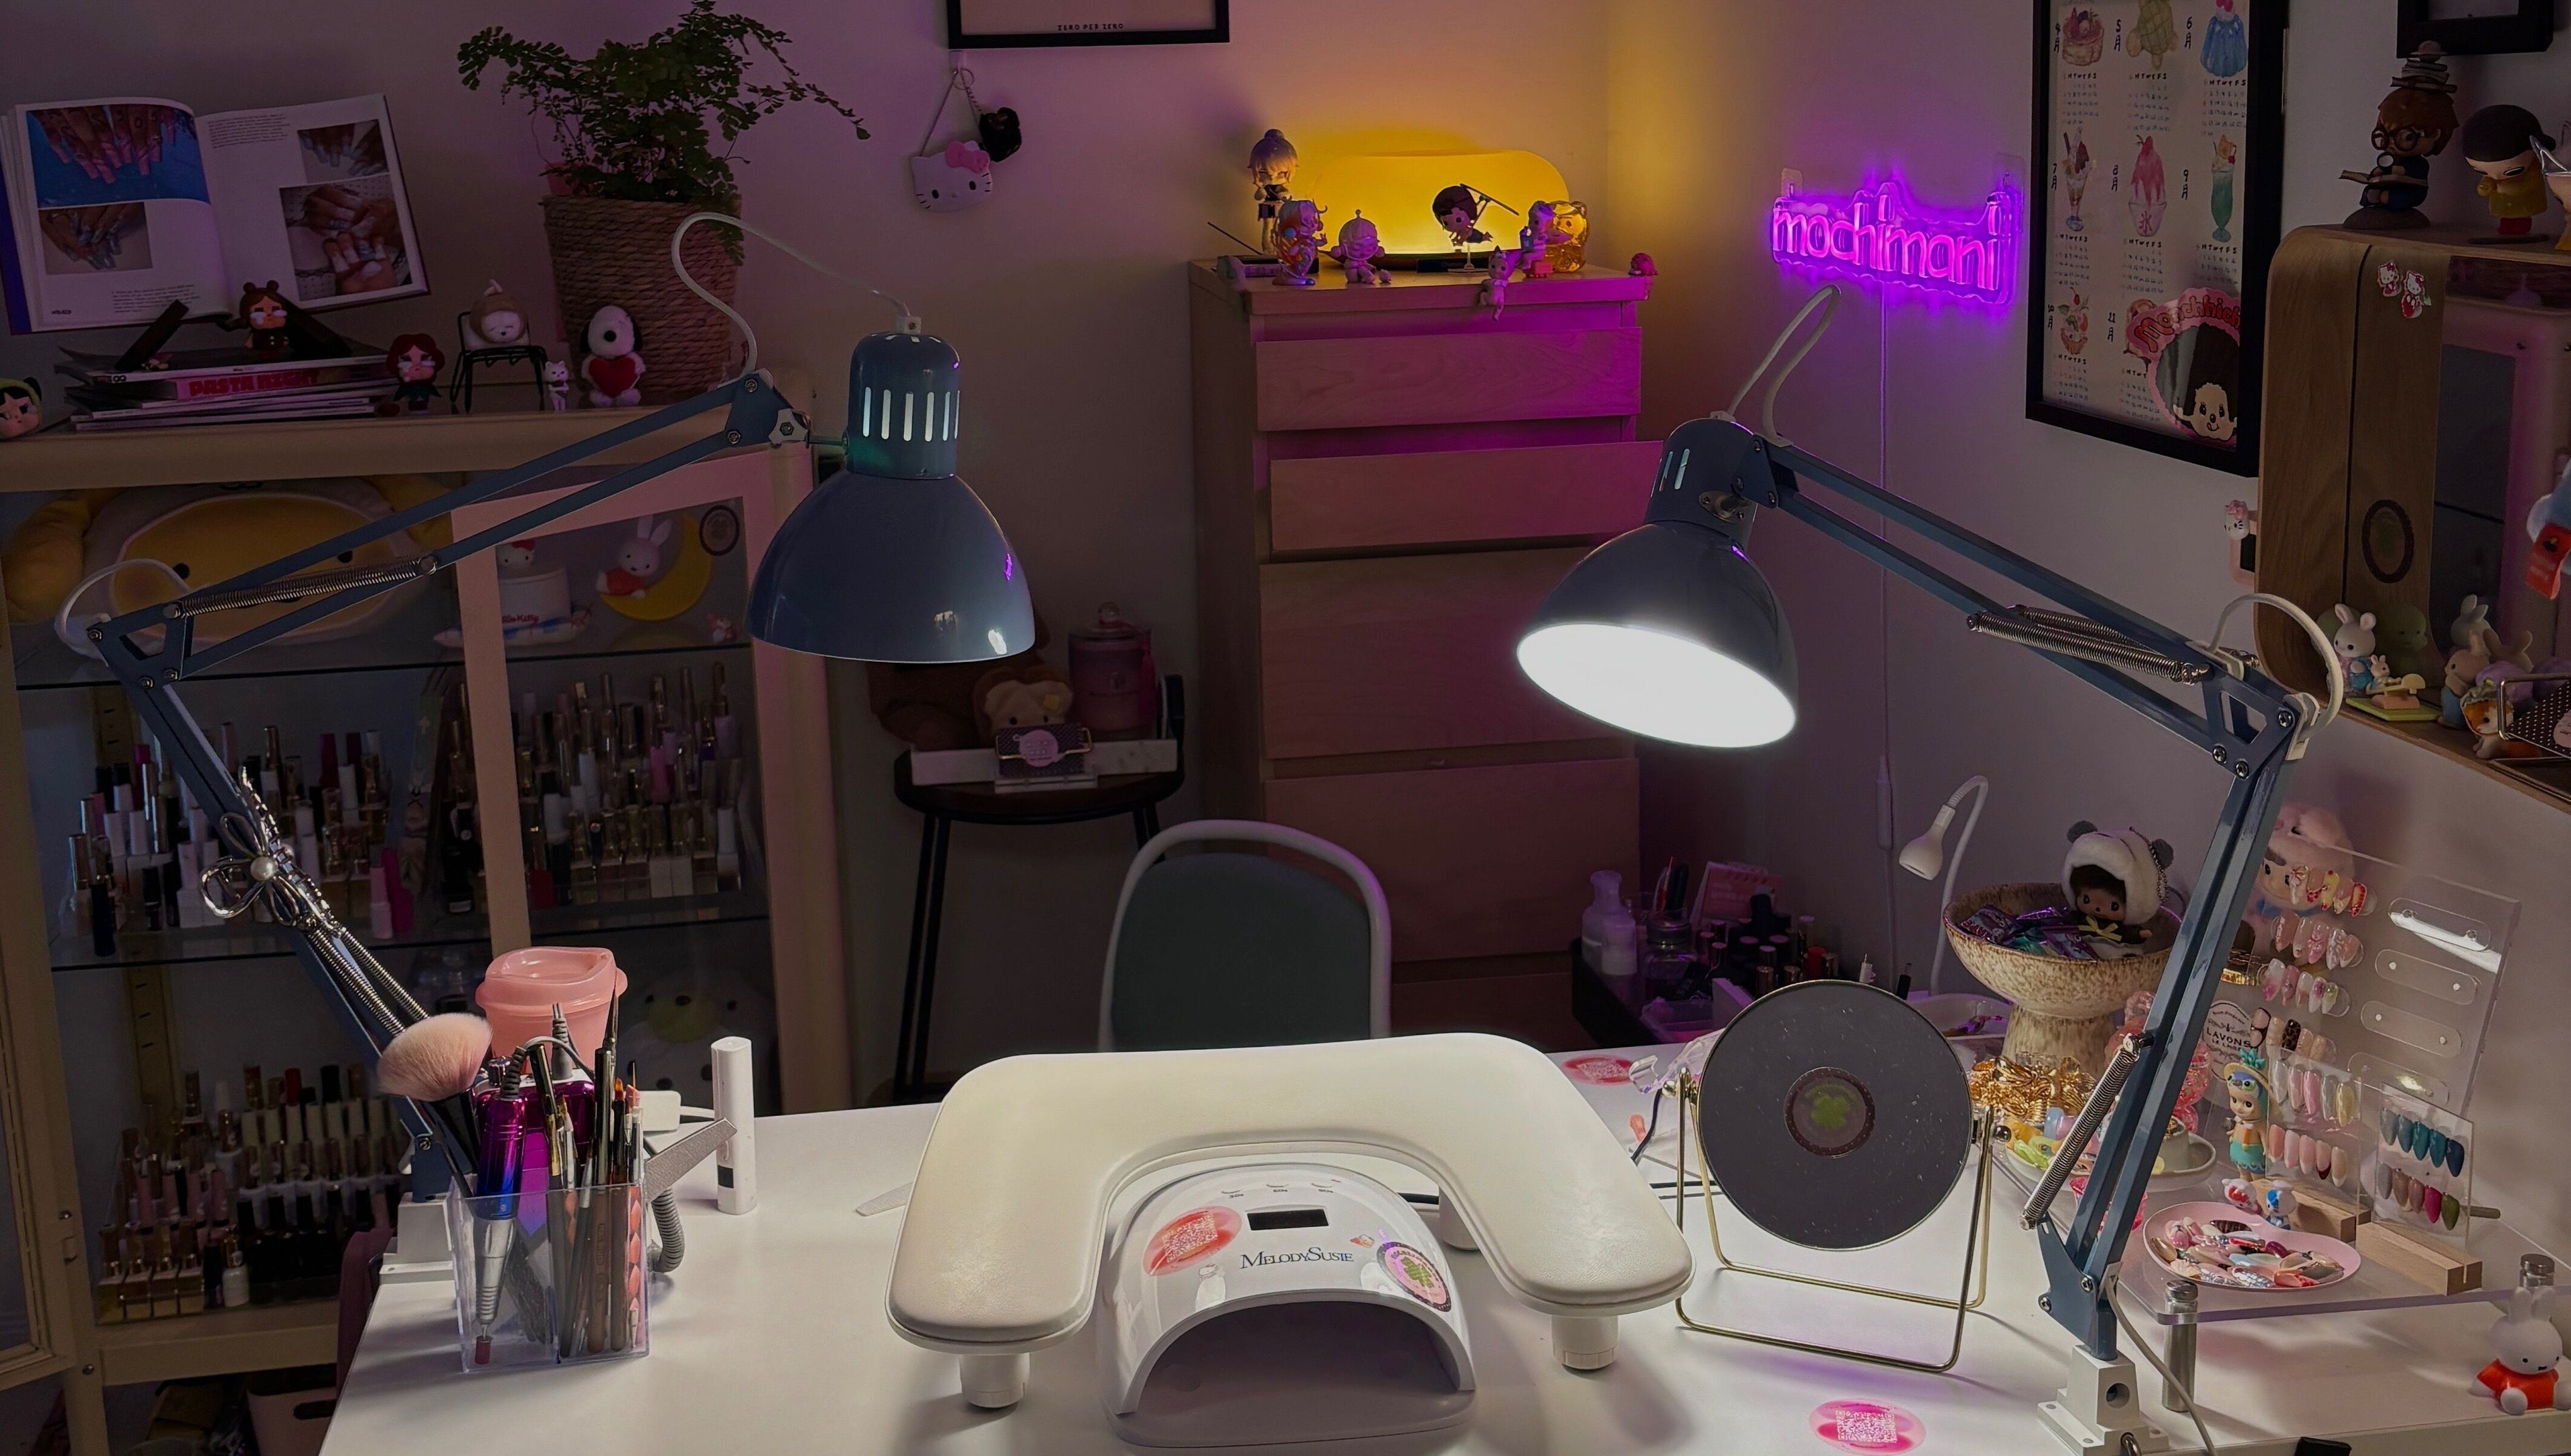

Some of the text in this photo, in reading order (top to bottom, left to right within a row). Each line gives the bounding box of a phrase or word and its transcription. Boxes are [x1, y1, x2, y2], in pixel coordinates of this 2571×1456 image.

[1772, 194, 2002, 290] mochimani
[189, 376, 254, 397] PASTA
[2207, 1027, 2251, 1048] LAVONS
